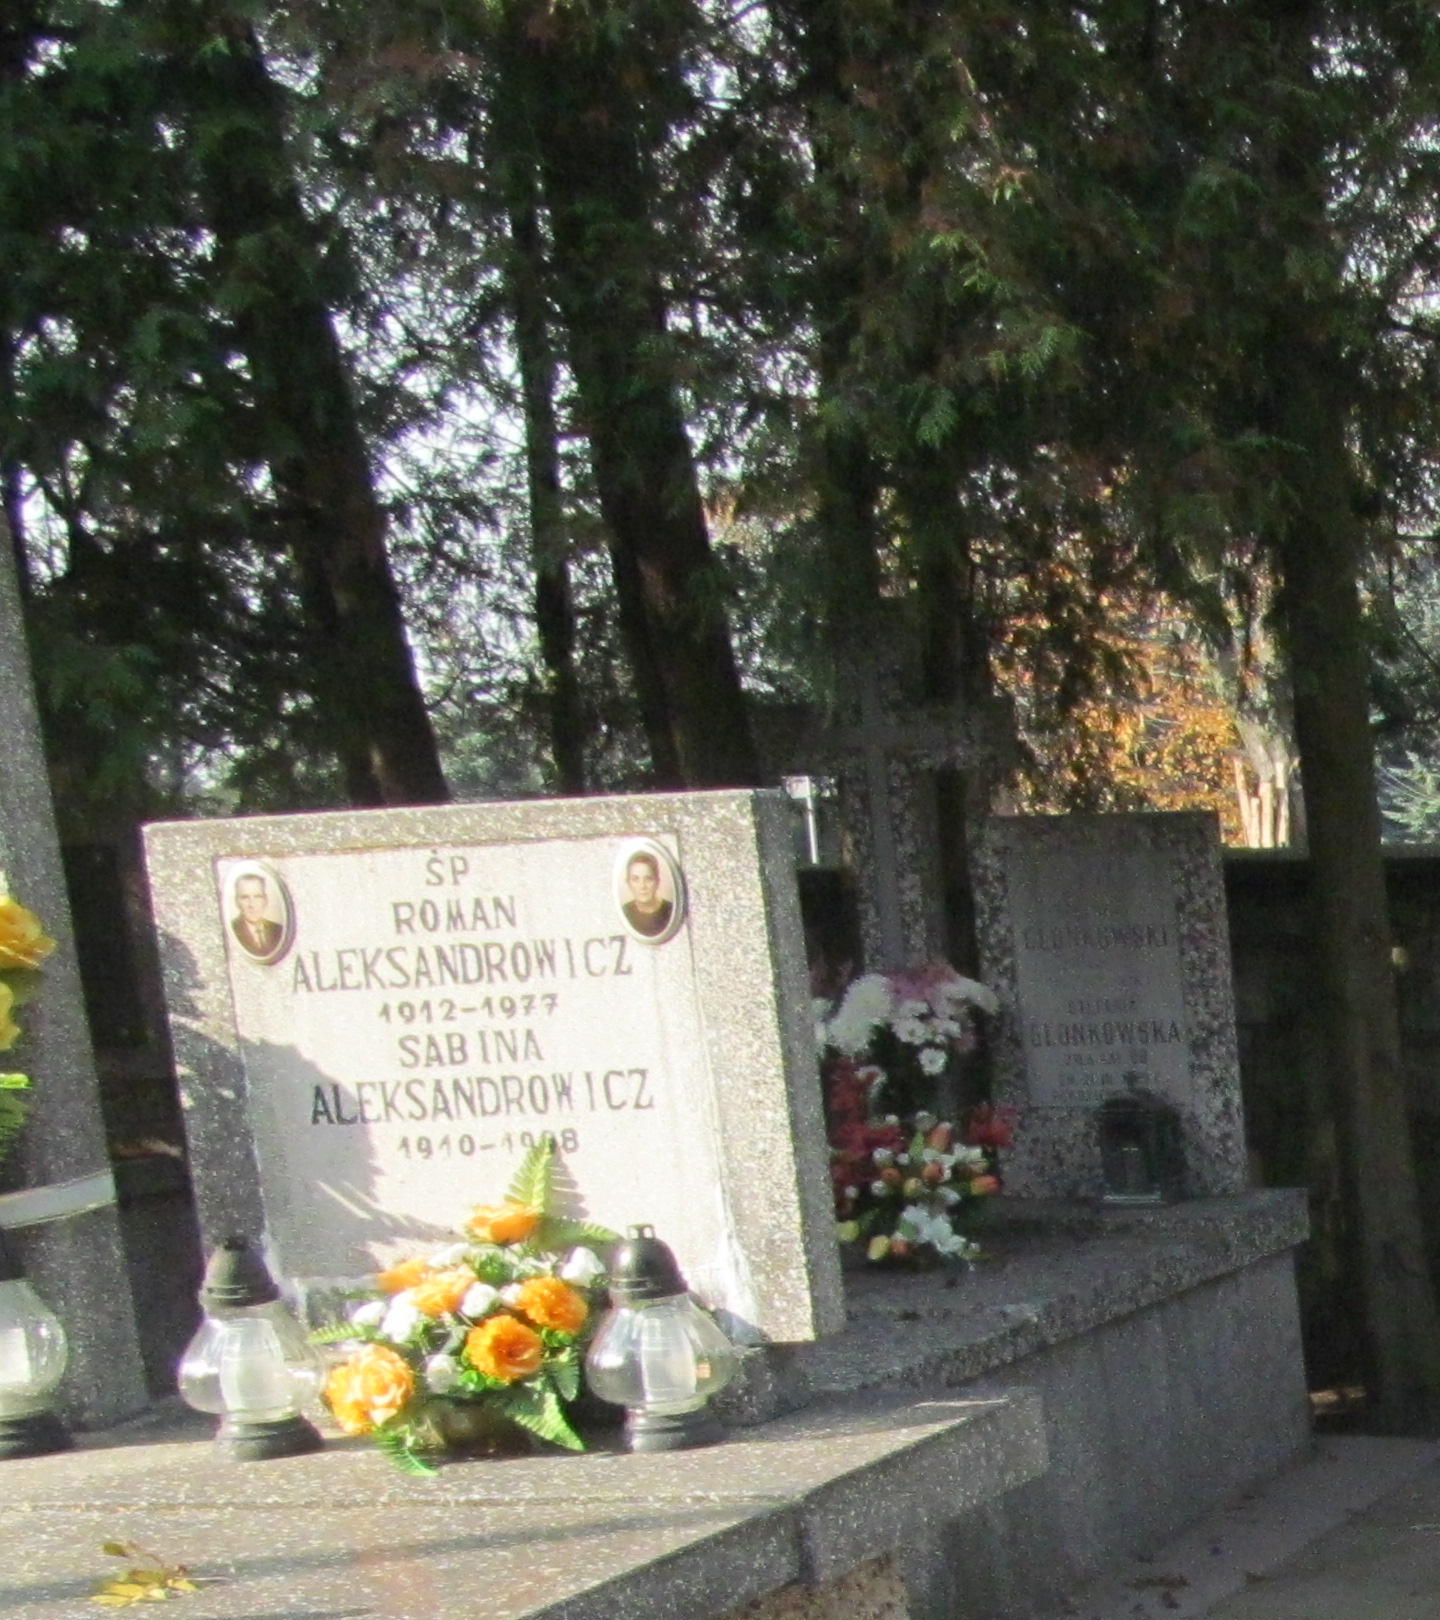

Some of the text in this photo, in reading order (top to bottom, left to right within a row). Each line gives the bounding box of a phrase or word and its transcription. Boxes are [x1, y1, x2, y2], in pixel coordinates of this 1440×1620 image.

[392, 896, 517, 935] ROMAN
[292, 935, 634, 994] ALEKSANDROWICZ
[378, 993, 560, 1026] 1912-1977
[399, 1029, 544, 1068] SABINA
[311, 1069, 654, 1126] ALEKSANDROWICZ
